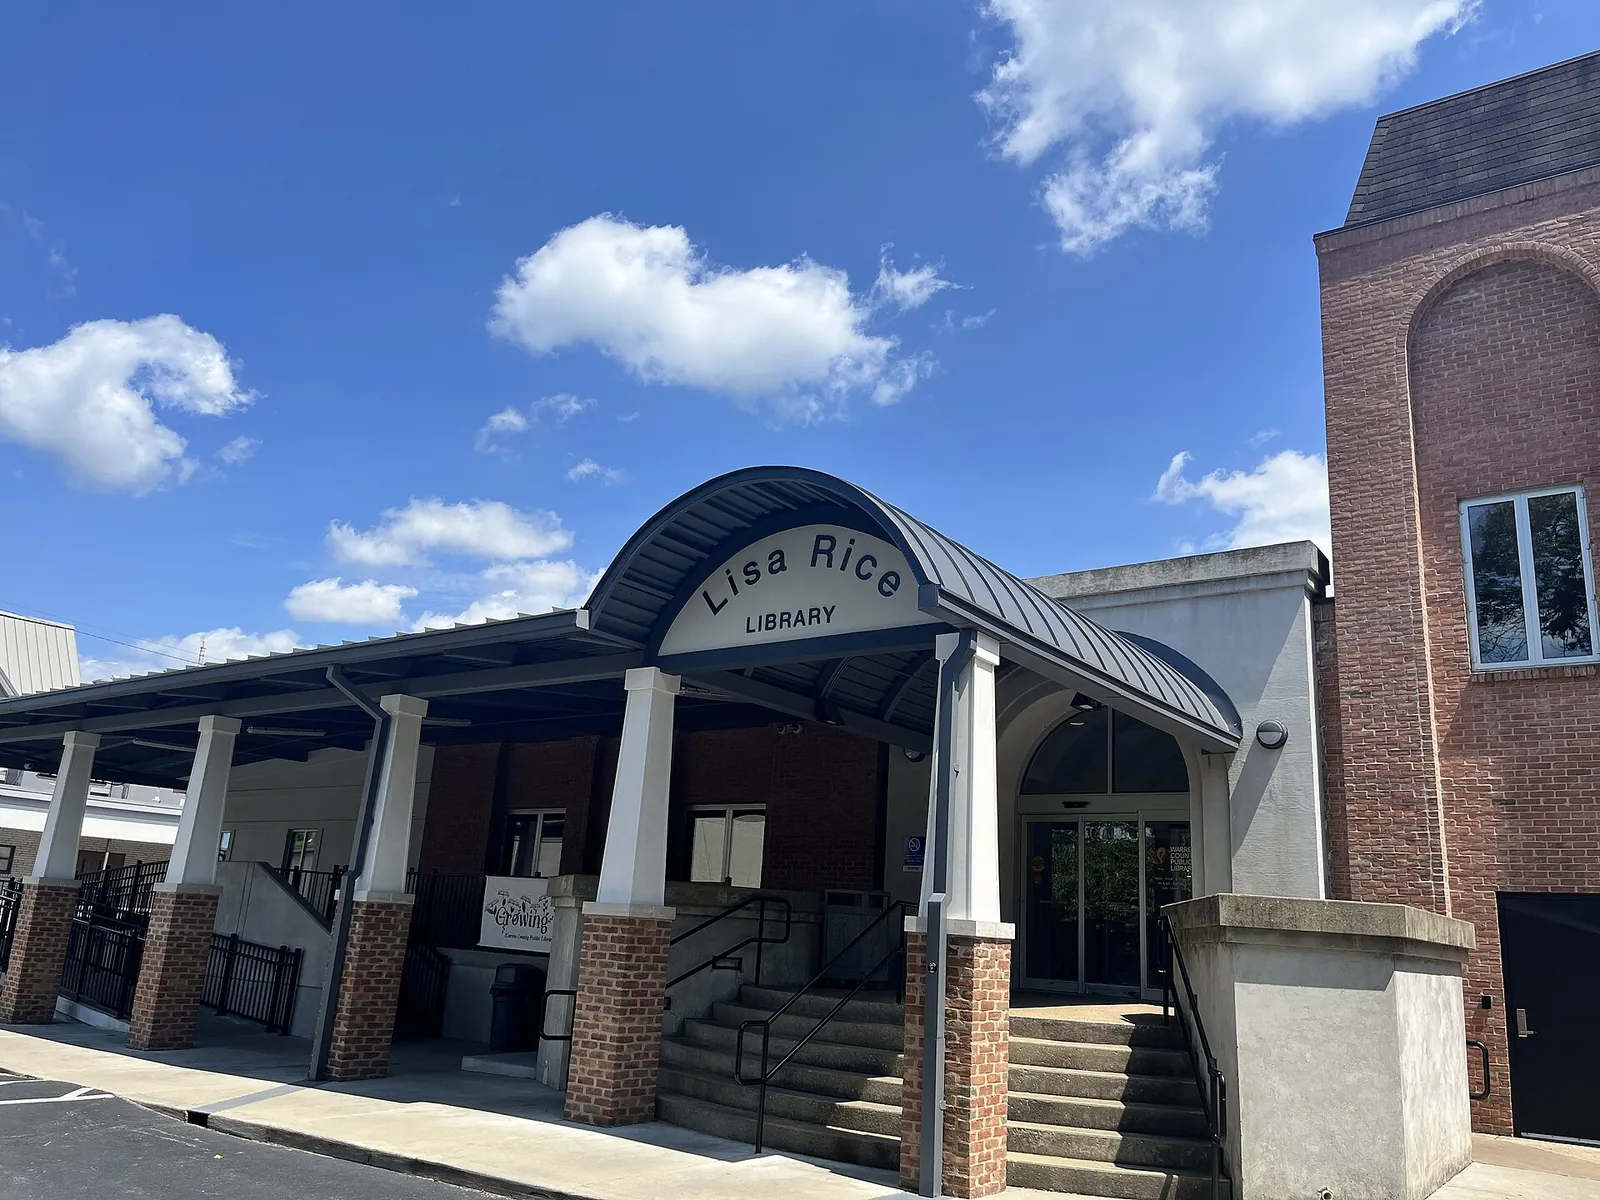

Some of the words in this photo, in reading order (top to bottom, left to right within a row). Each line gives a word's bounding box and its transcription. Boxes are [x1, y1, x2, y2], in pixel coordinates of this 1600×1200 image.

[702, 549, 787, 616] Lisa
[810, 534, 901, 597] Rice
[746, 605, 836, 633] LIBRARY
[495, 906, 549, 935] Growing
